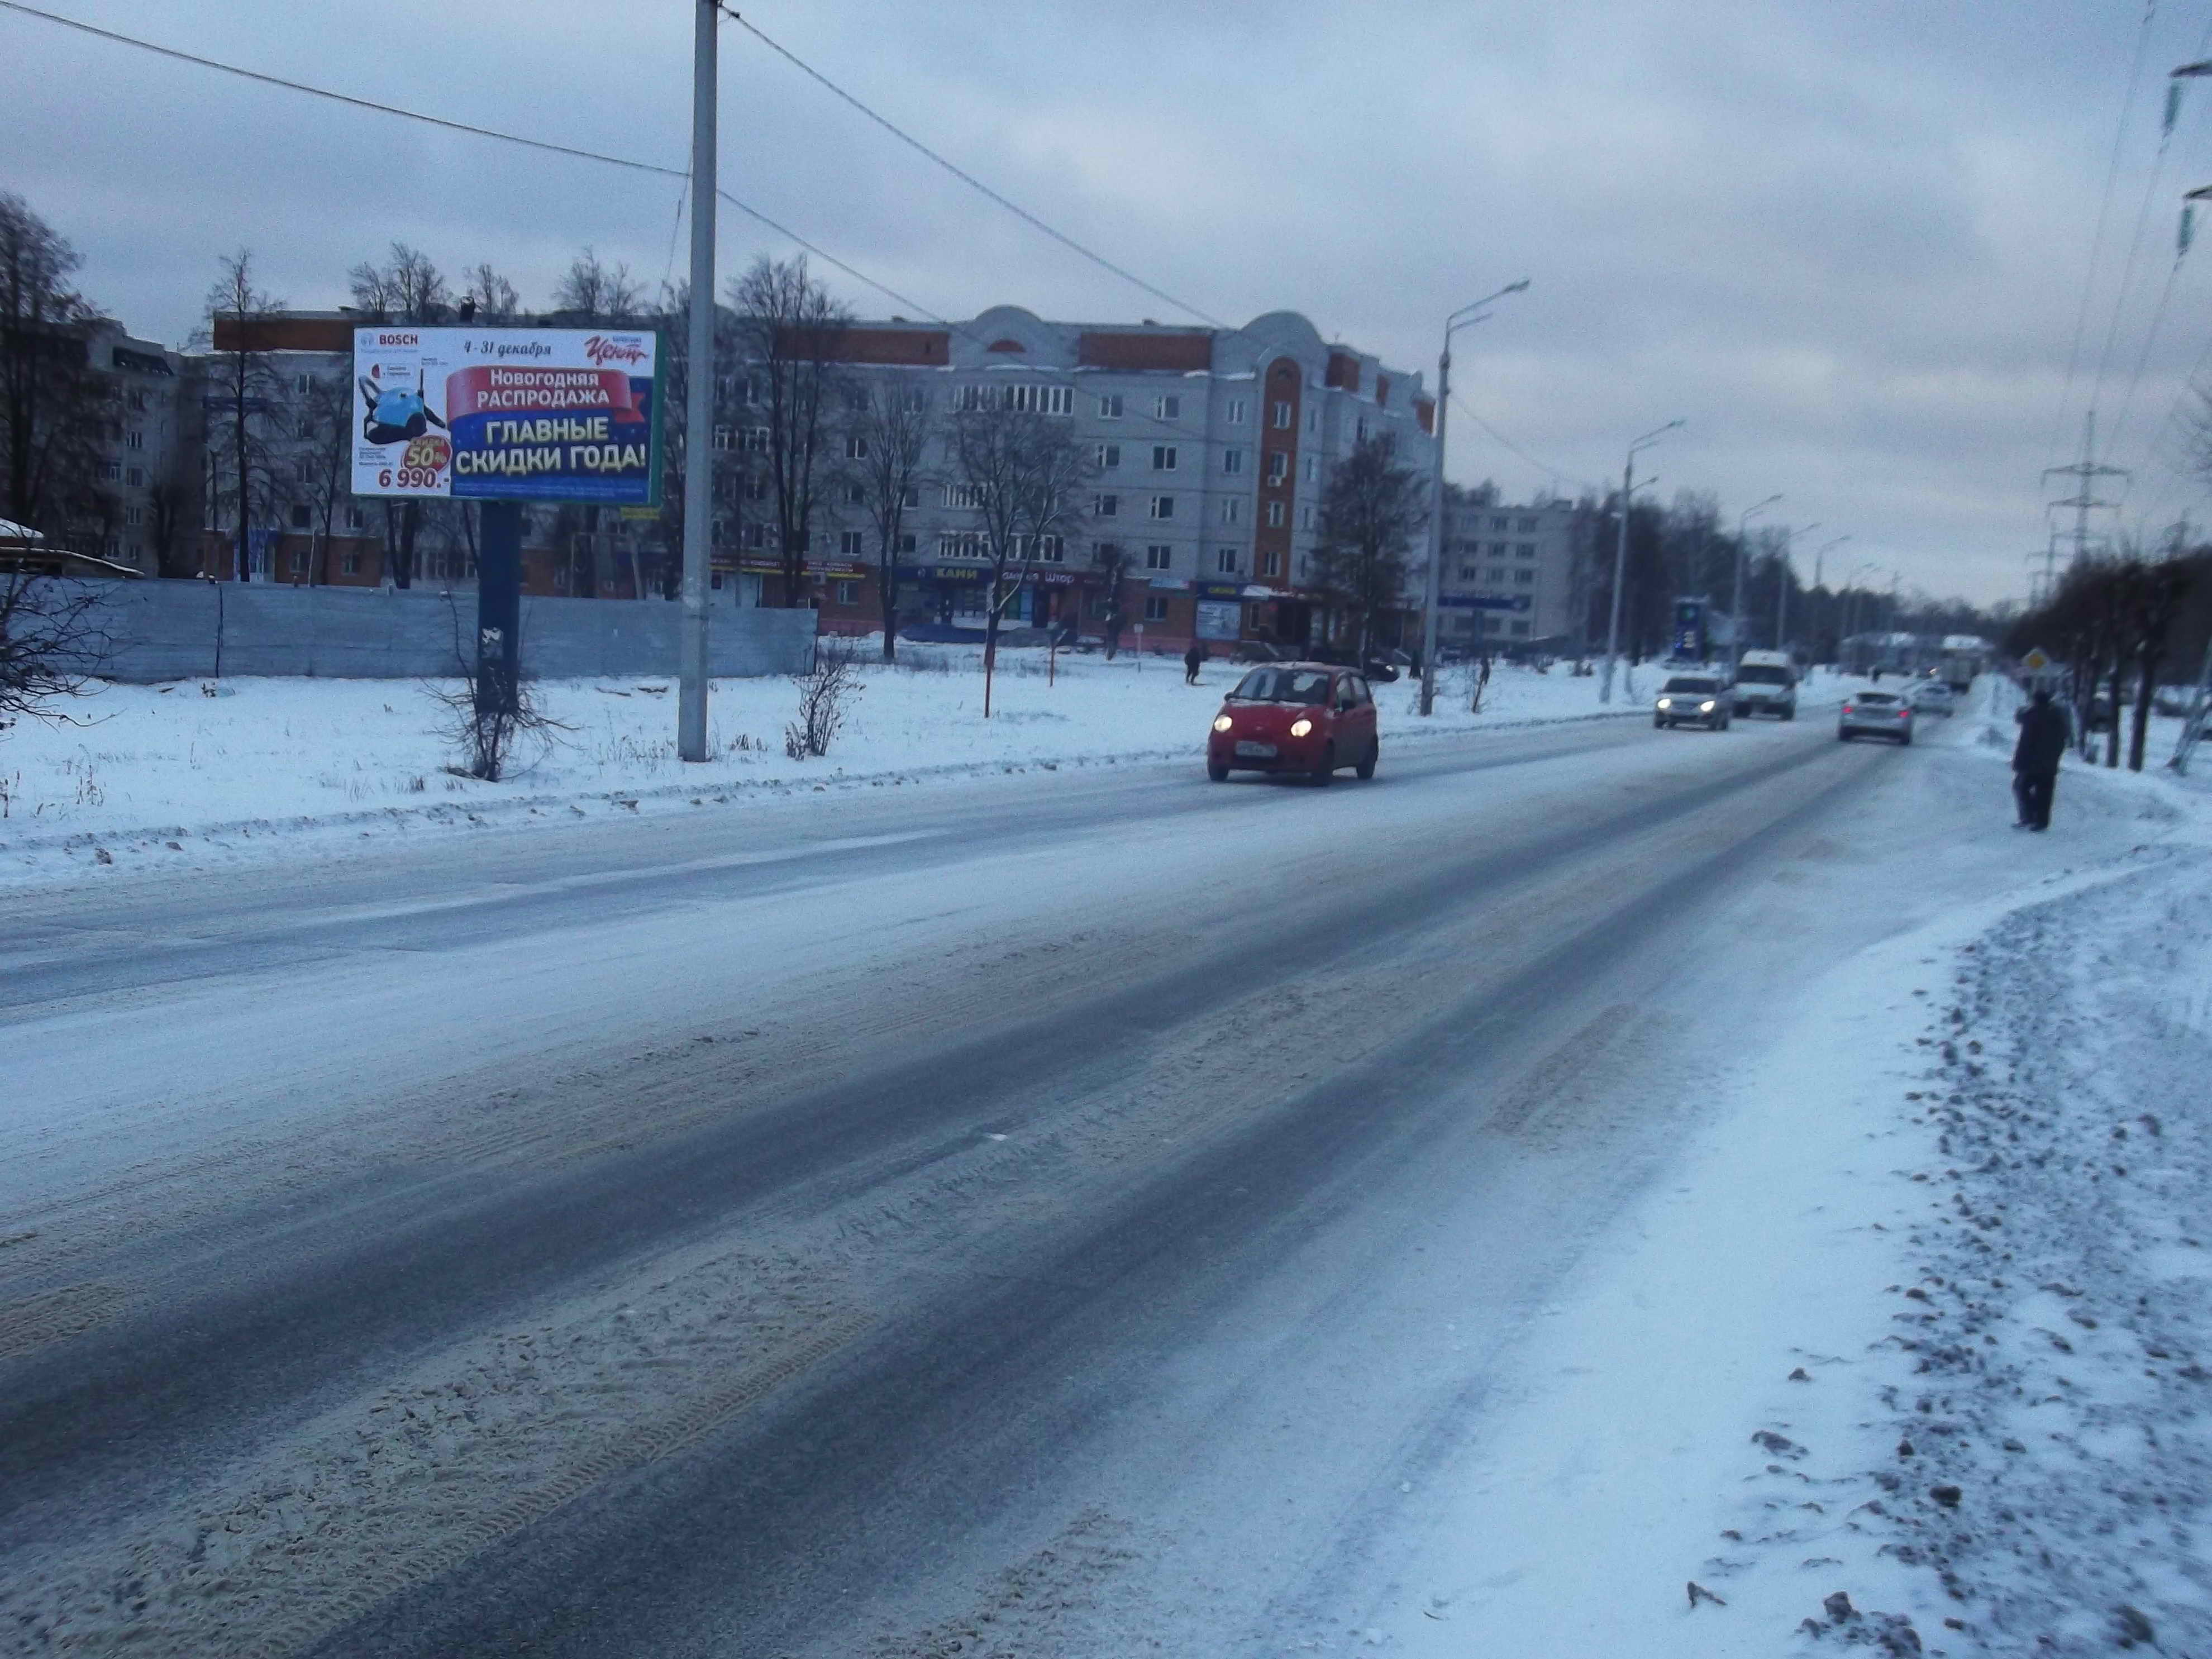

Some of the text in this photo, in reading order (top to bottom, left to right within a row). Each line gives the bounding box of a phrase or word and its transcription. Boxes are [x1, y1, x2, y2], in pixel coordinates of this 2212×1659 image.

[379, 335, 418, 345] BOSCH
[480, 341, 494, 354] 31
[498, 342, 551, 357] декабря
[477, 389, 610, 408] РАСПРОДАЖА
[487, 417, 609, 444] ГЛАВНЫЕ
[406, 447, 447, 466] 50%
[456, 443, 646, 475] СКИДКИ ГОДА!
[1045, 572, 1075, 585] Штор
